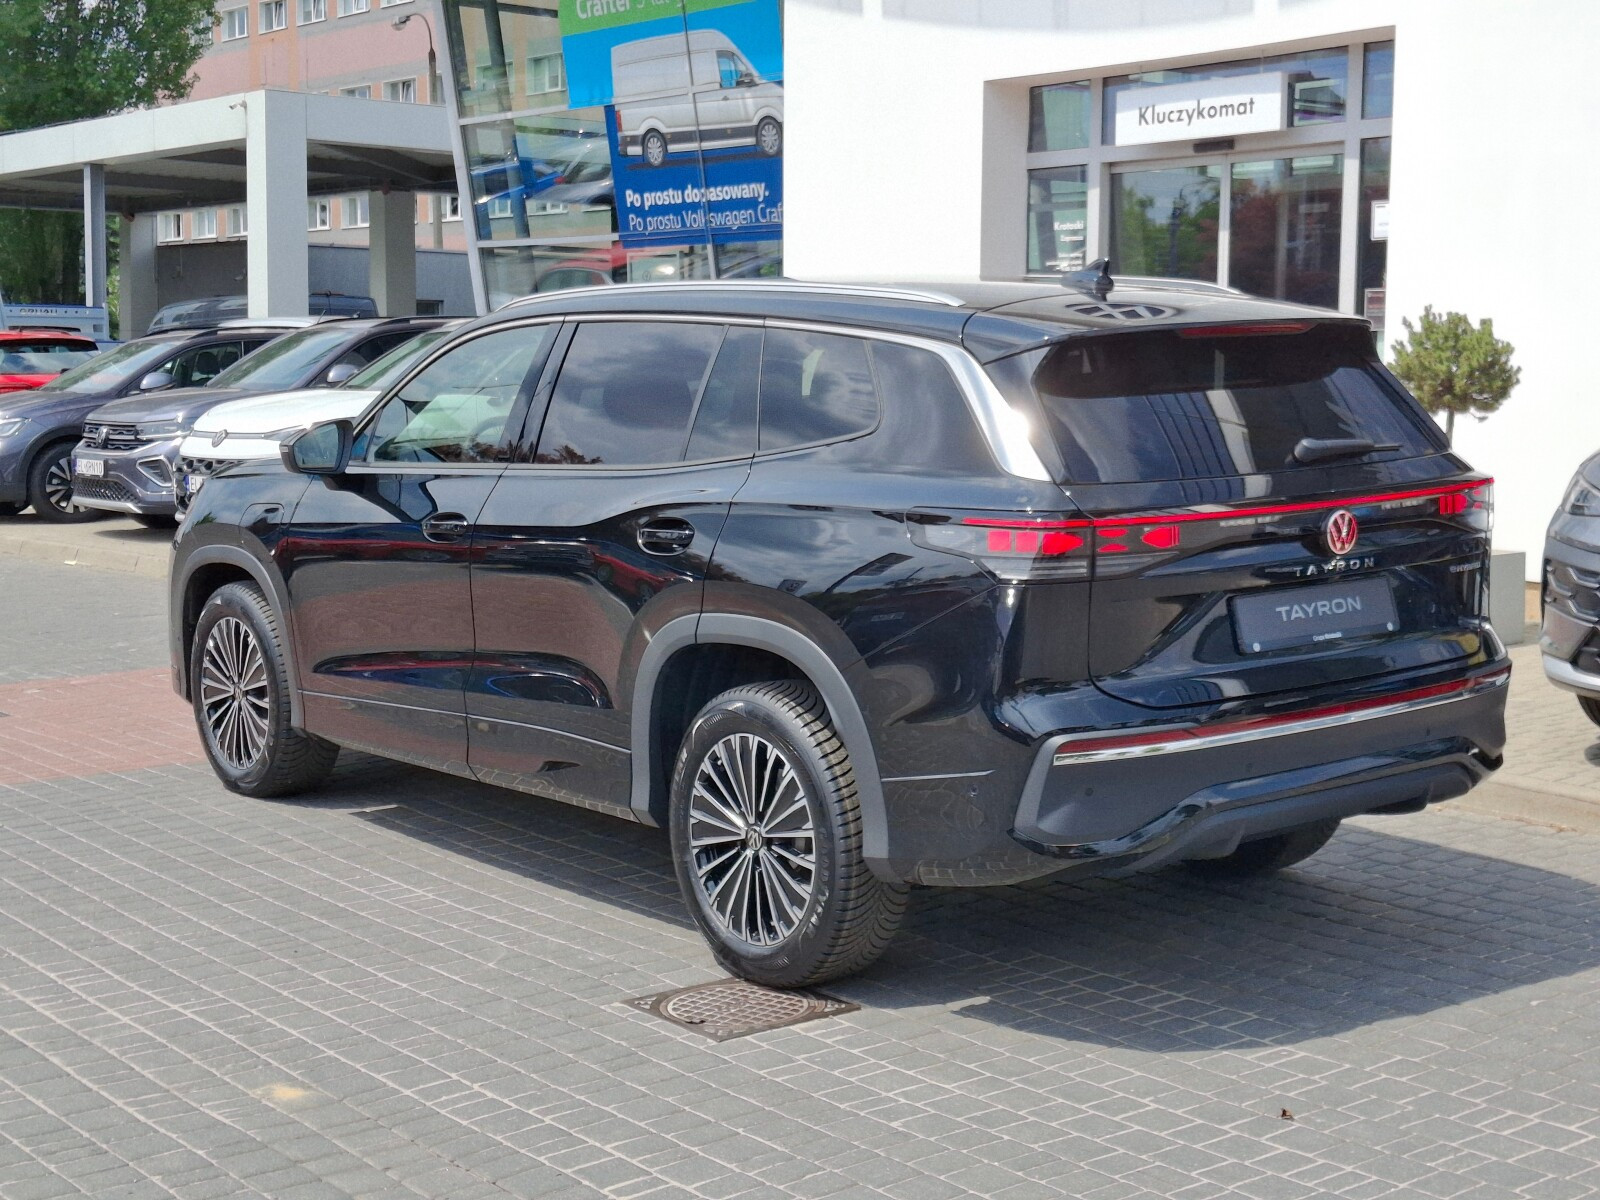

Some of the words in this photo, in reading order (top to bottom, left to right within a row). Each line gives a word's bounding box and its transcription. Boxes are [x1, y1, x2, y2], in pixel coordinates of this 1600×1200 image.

[576, 0, 630, 20] Crafter
[1138, 97, 1255, 126] Kluczykomat
[625, 189, 641, 207] Po
[643, 188, 682, 210] prostu
[629, 214, 643, 231] Po
[646, 213, 681, 235] prostu
[1294, 558, 1375, 577] TAYRON
[1275, 596, 1362, 622] TAYRON
